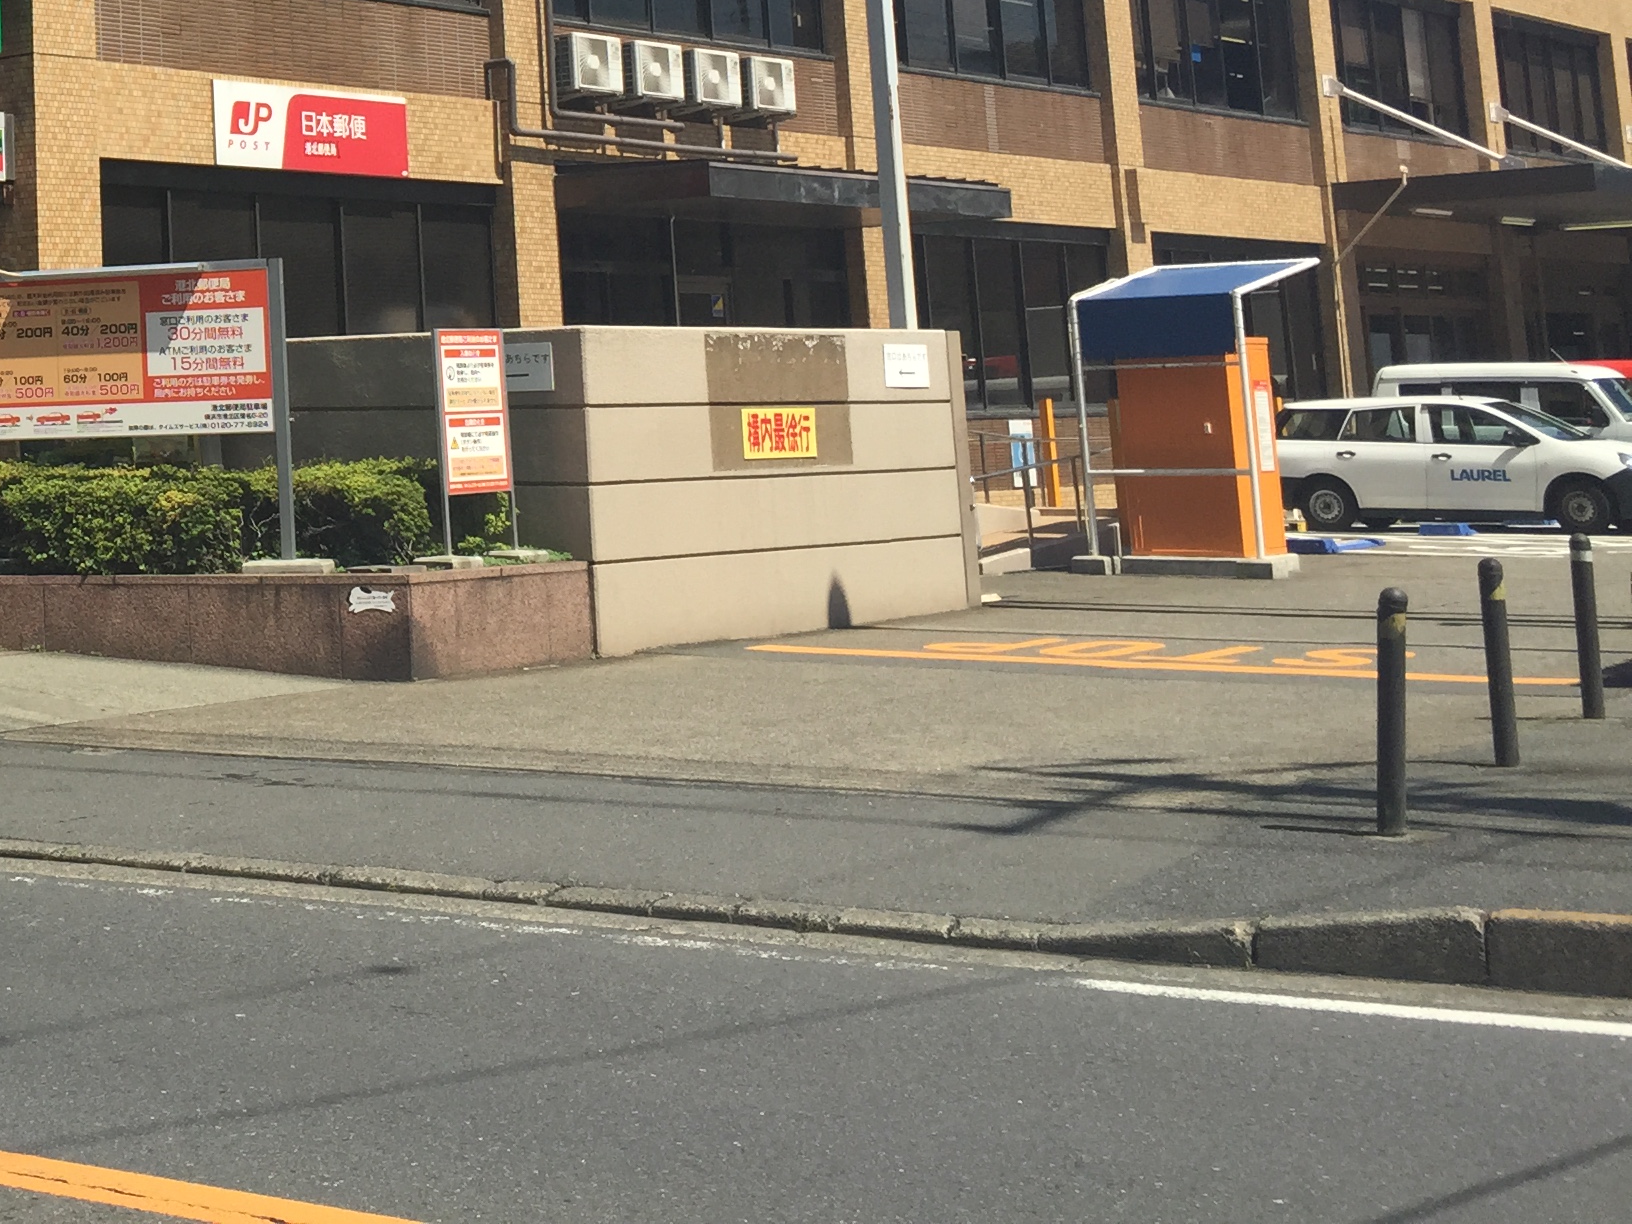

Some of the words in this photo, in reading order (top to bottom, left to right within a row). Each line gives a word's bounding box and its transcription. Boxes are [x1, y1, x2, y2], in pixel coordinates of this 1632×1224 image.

[301, 111, 367, 139] 日本郵便
[228, 139, 270, 151] POST
[167, 326, 244, 341] 30分間無料
[171, 356, 245, 371] 15分間無料
[15, 387, 54, 399] 500円
[99, 384, 139, 396] 500円
[747, 413, 811, 452] 構内最徐行
[1450, 469, 1512, 482] LAUREL
[923, 637, 1416, 668] STOP
